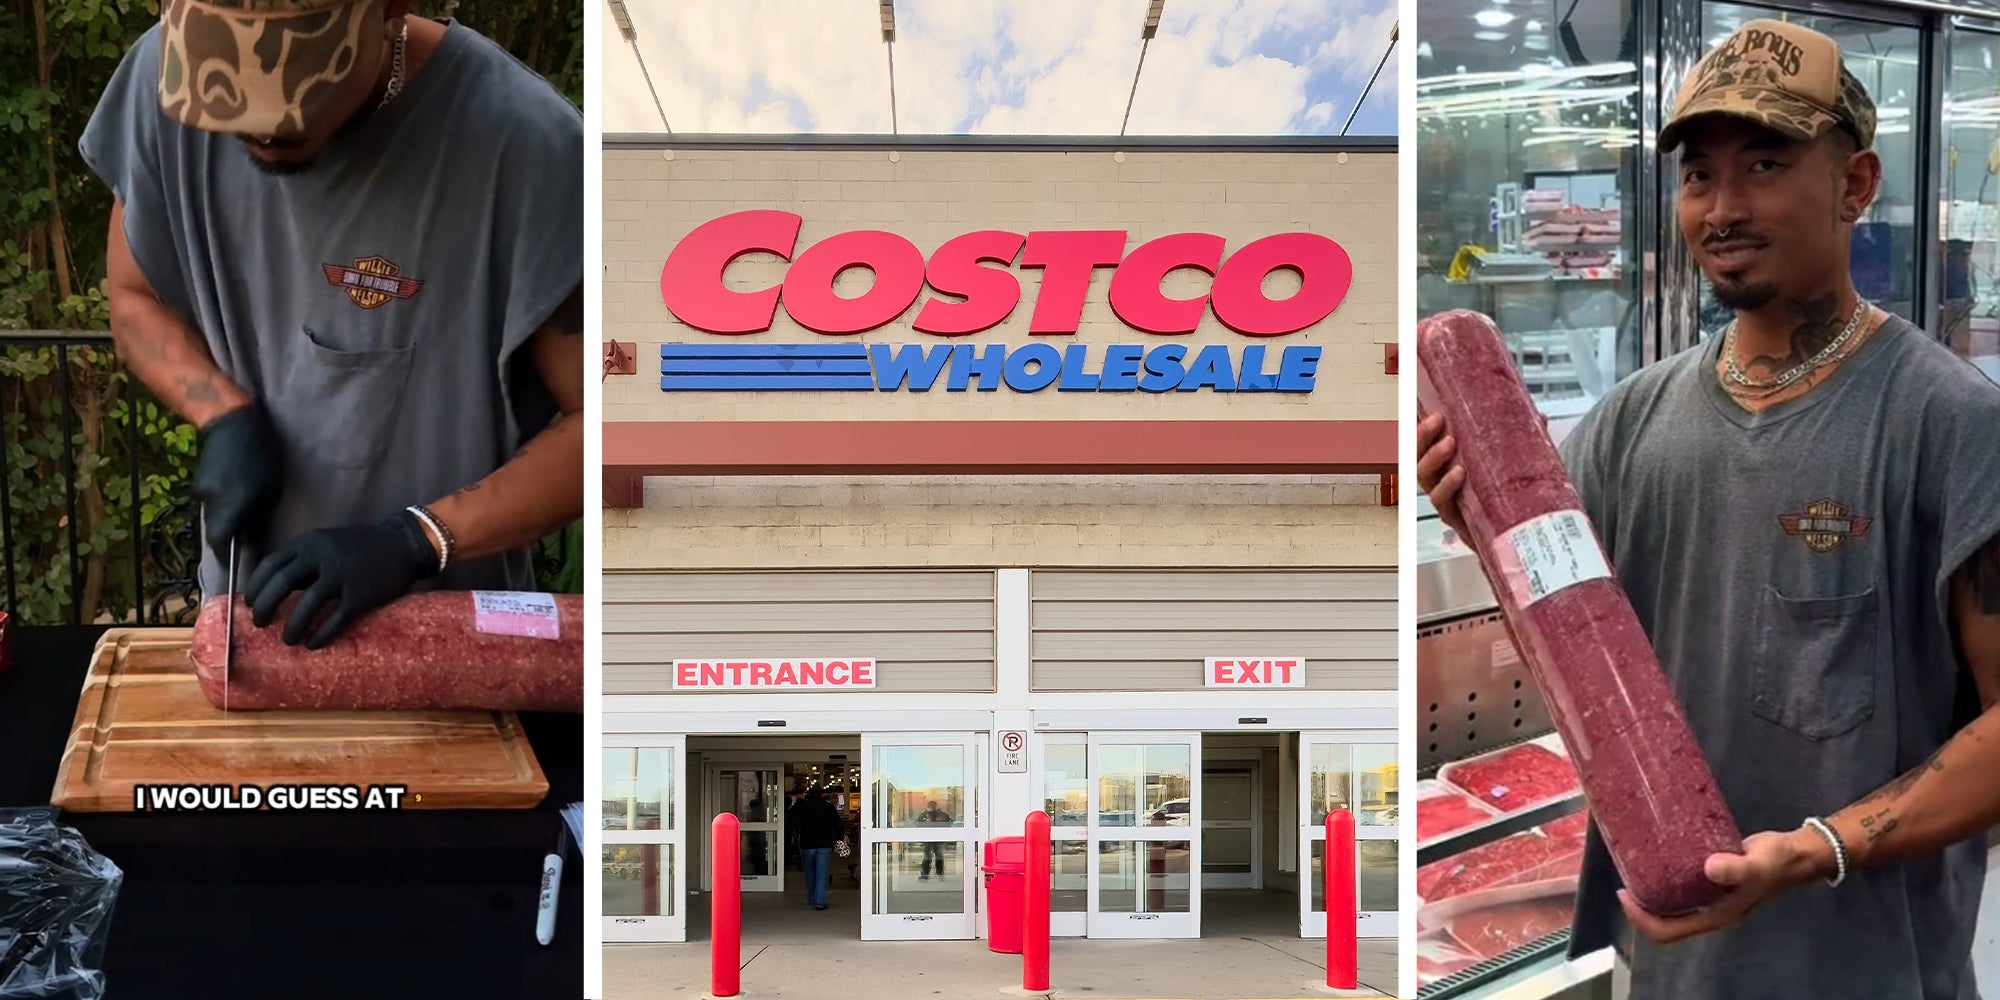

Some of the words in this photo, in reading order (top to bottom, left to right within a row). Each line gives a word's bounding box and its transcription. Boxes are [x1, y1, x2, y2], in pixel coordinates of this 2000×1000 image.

[359, 260, 392, 275] WILLIE
[660, 209, 1353, 335] COSTCO
[351, 288, 384, 306] NELSON
[870, 343, 1323, 393] WHOLESALE
[677, 661, 873, 686] ENTRANCE
[1214, 660, 1297, 684] EXIT
